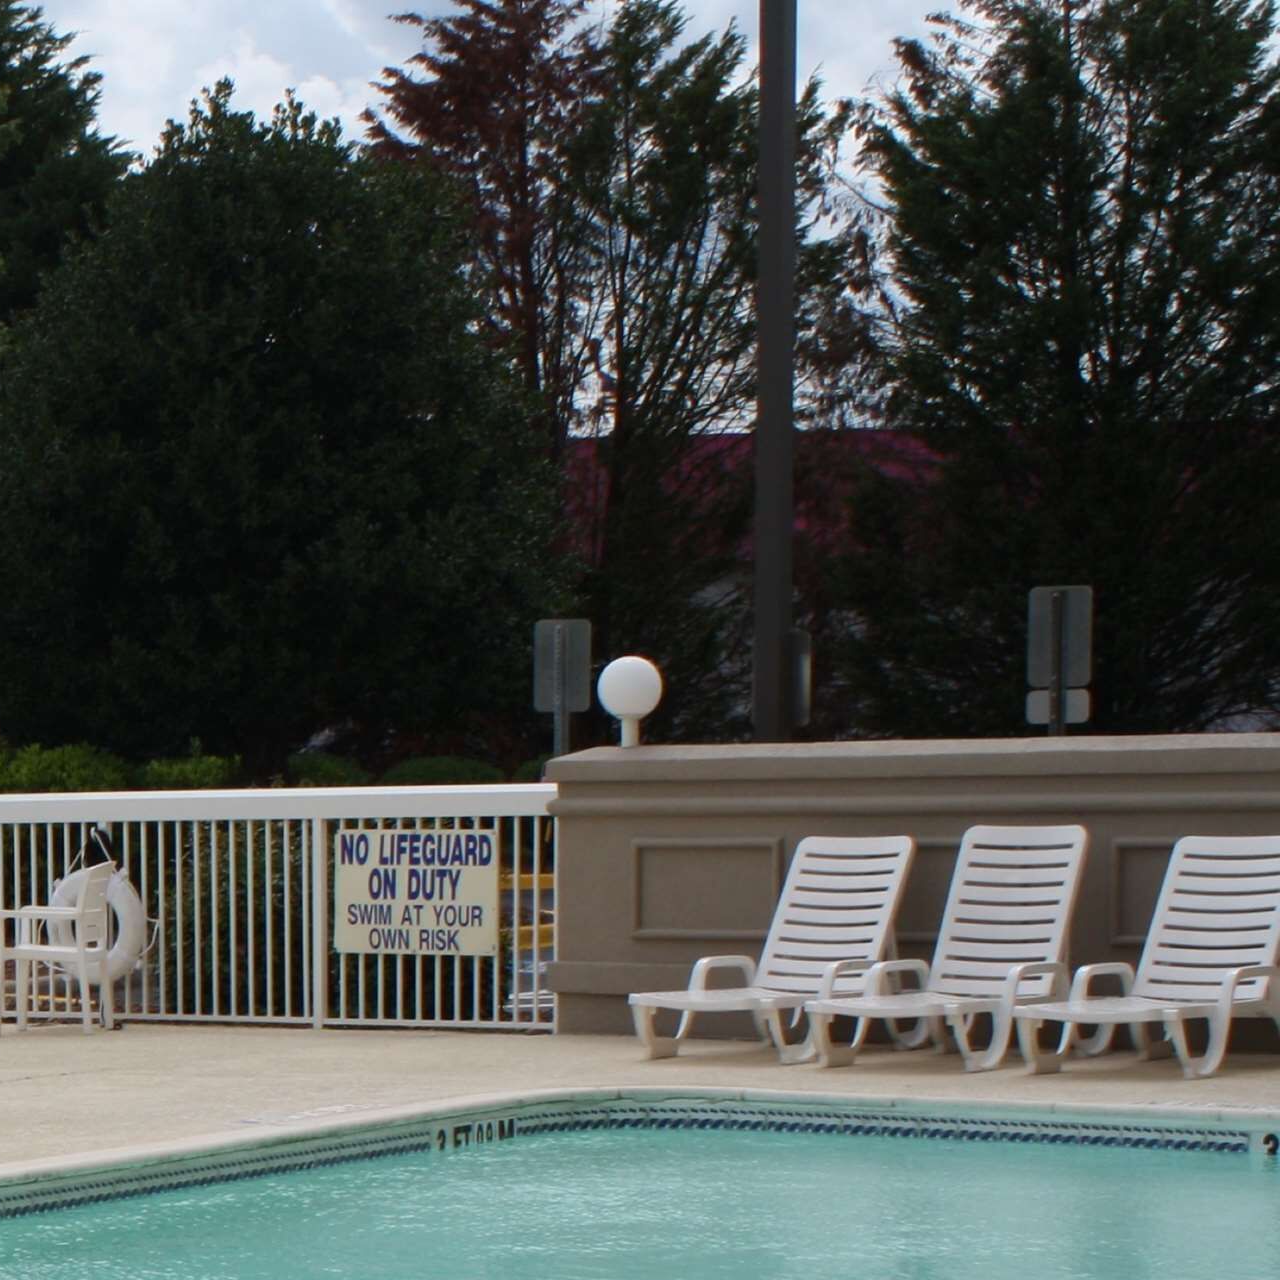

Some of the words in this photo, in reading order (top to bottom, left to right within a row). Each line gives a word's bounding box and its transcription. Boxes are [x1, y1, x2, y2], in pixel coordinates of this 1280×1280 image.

[340, 834, 369, 866] NO
[378, 834, 492, 866] LIFEGUARD
[368, 868, 397, 900] ON
[407, 868, 462, 900] DUTY
[347, 903, 392, 926] SWIM
[400, 904, 424, 926] AT
[432, 905, 483, 927] YOUR
[368, 928, 409, 950] OWN
[419, 929, 460, 951] RISK
